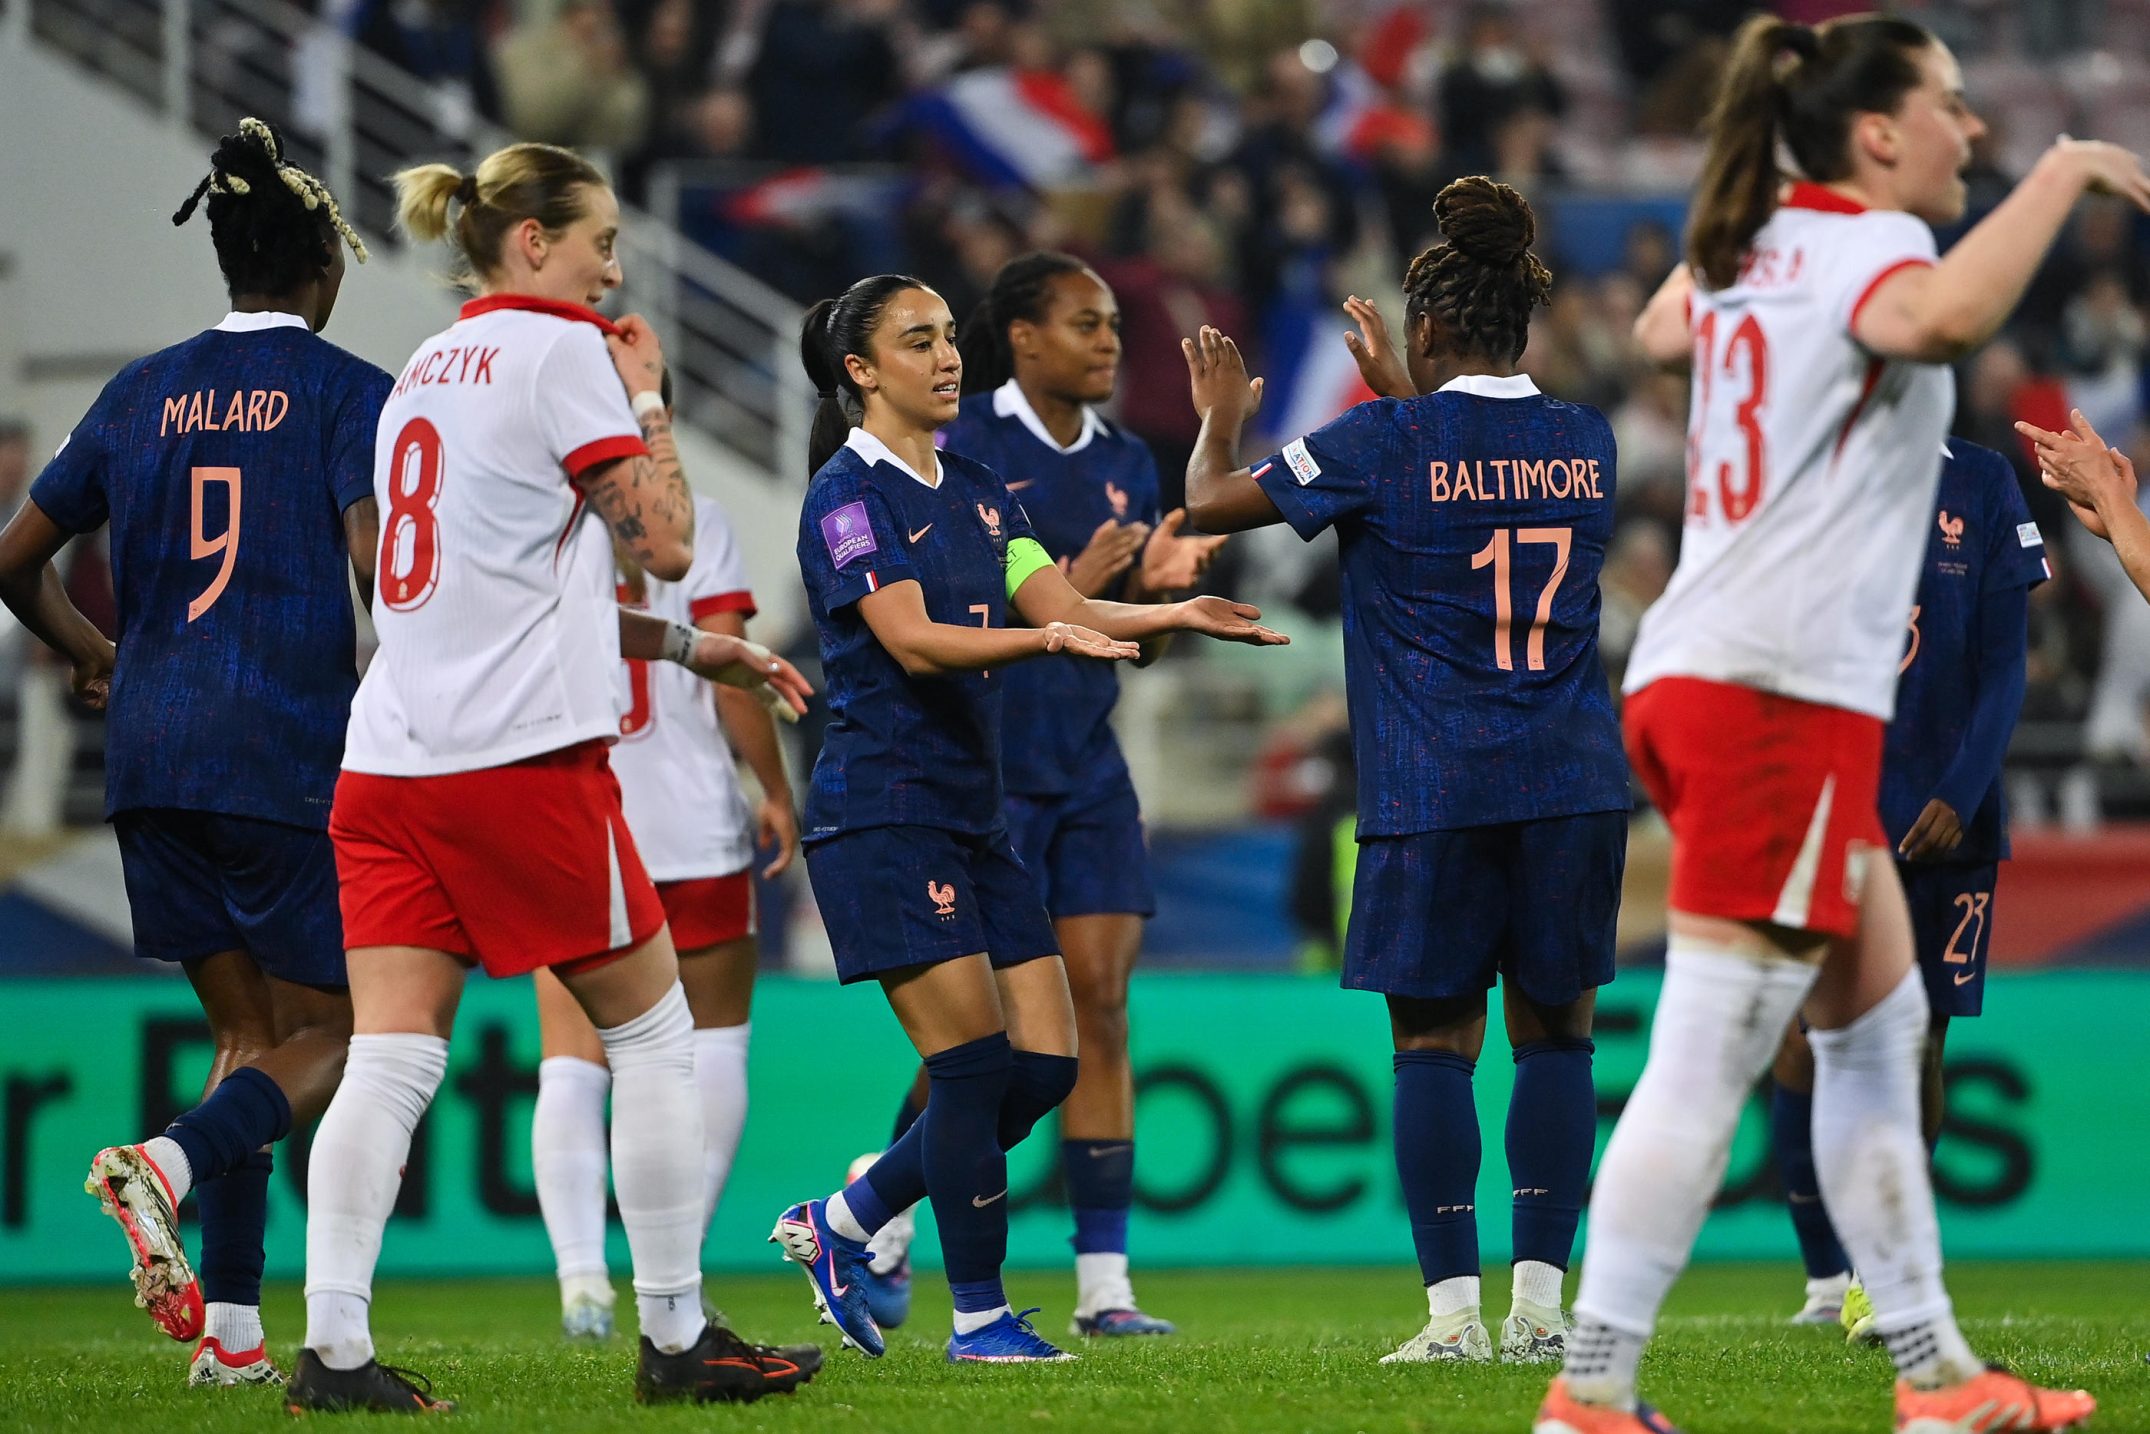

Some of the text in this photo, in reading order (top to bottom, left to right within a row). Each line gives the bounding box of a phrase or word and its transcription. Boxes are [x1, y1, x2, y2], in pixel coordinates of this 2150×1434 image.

[160, 389, 289, 437] MALARD
[1430, 459, 1603, 502] BALTIMORE
[380, 417, 444, 612] 8
[834, 533, 868, 555] EUROPEAN
[188, 467, 241, 623] 9
[835, 540, 871, 562] QUALIFIERS
[1472, 527, 1572, 671] 17
[1943, 892, 1989, 964] 23
